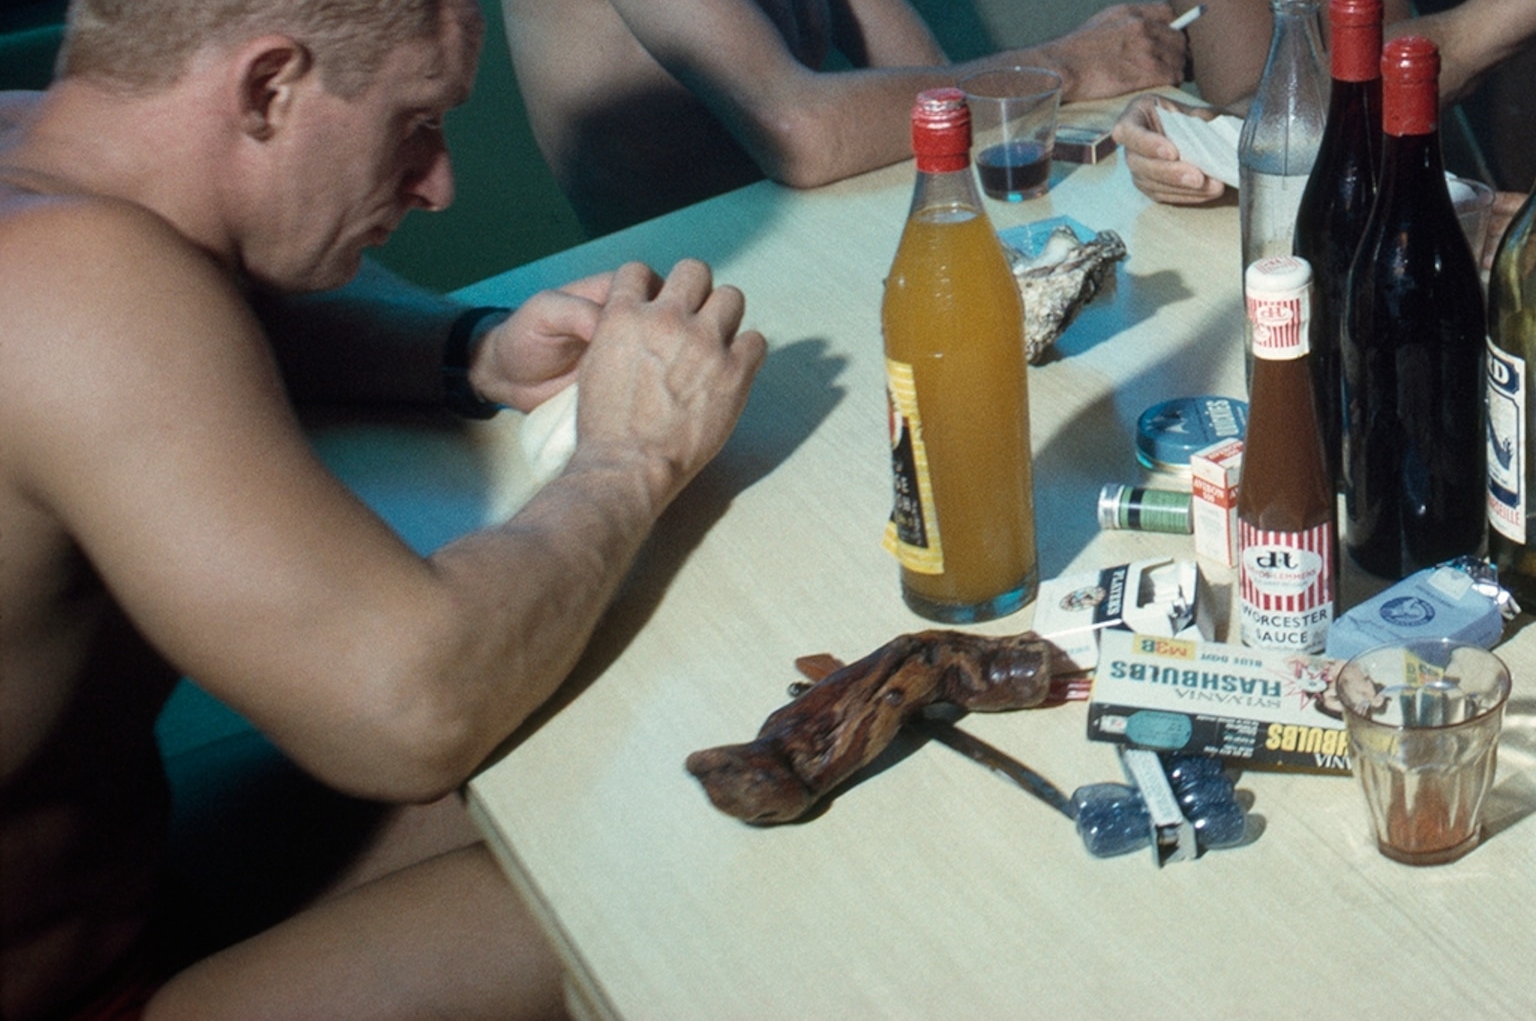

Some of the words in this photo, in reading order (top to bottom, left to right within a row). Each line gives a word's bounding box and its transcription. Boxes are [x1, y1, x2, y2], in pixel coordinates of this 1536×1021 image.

[1243, 606, 1328, 628] WORCESTER
[1141, 639, 1187, 657] M3B
[1110, 660, 1281, 698] FLASHBULBS
[1175, 688, 1281, 709] SYLVANIA
